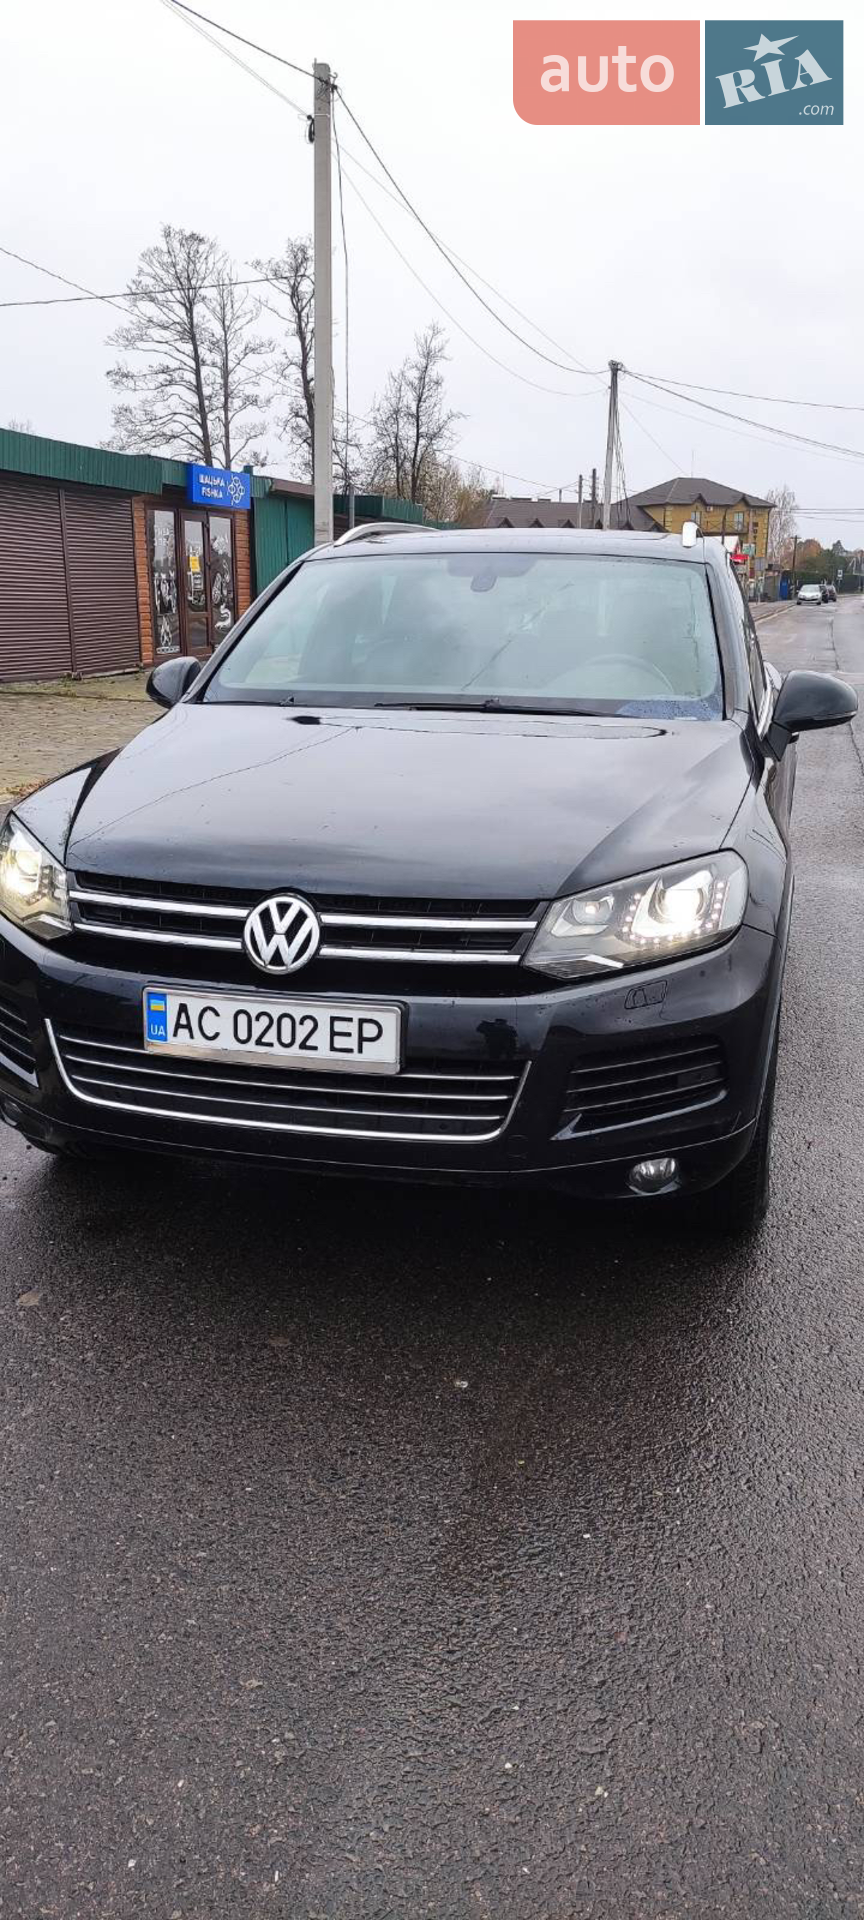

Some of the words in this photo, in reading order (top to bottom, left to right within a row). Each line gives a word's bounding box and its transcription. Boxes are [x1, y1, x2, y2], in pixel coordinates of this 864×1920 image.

[150, 1024, 166, 1037] UA
[172, 1002, 221, 1041] AC
[233, 1008, 319, 1051] 0202
[329, 1015, 384, 1054] EP
